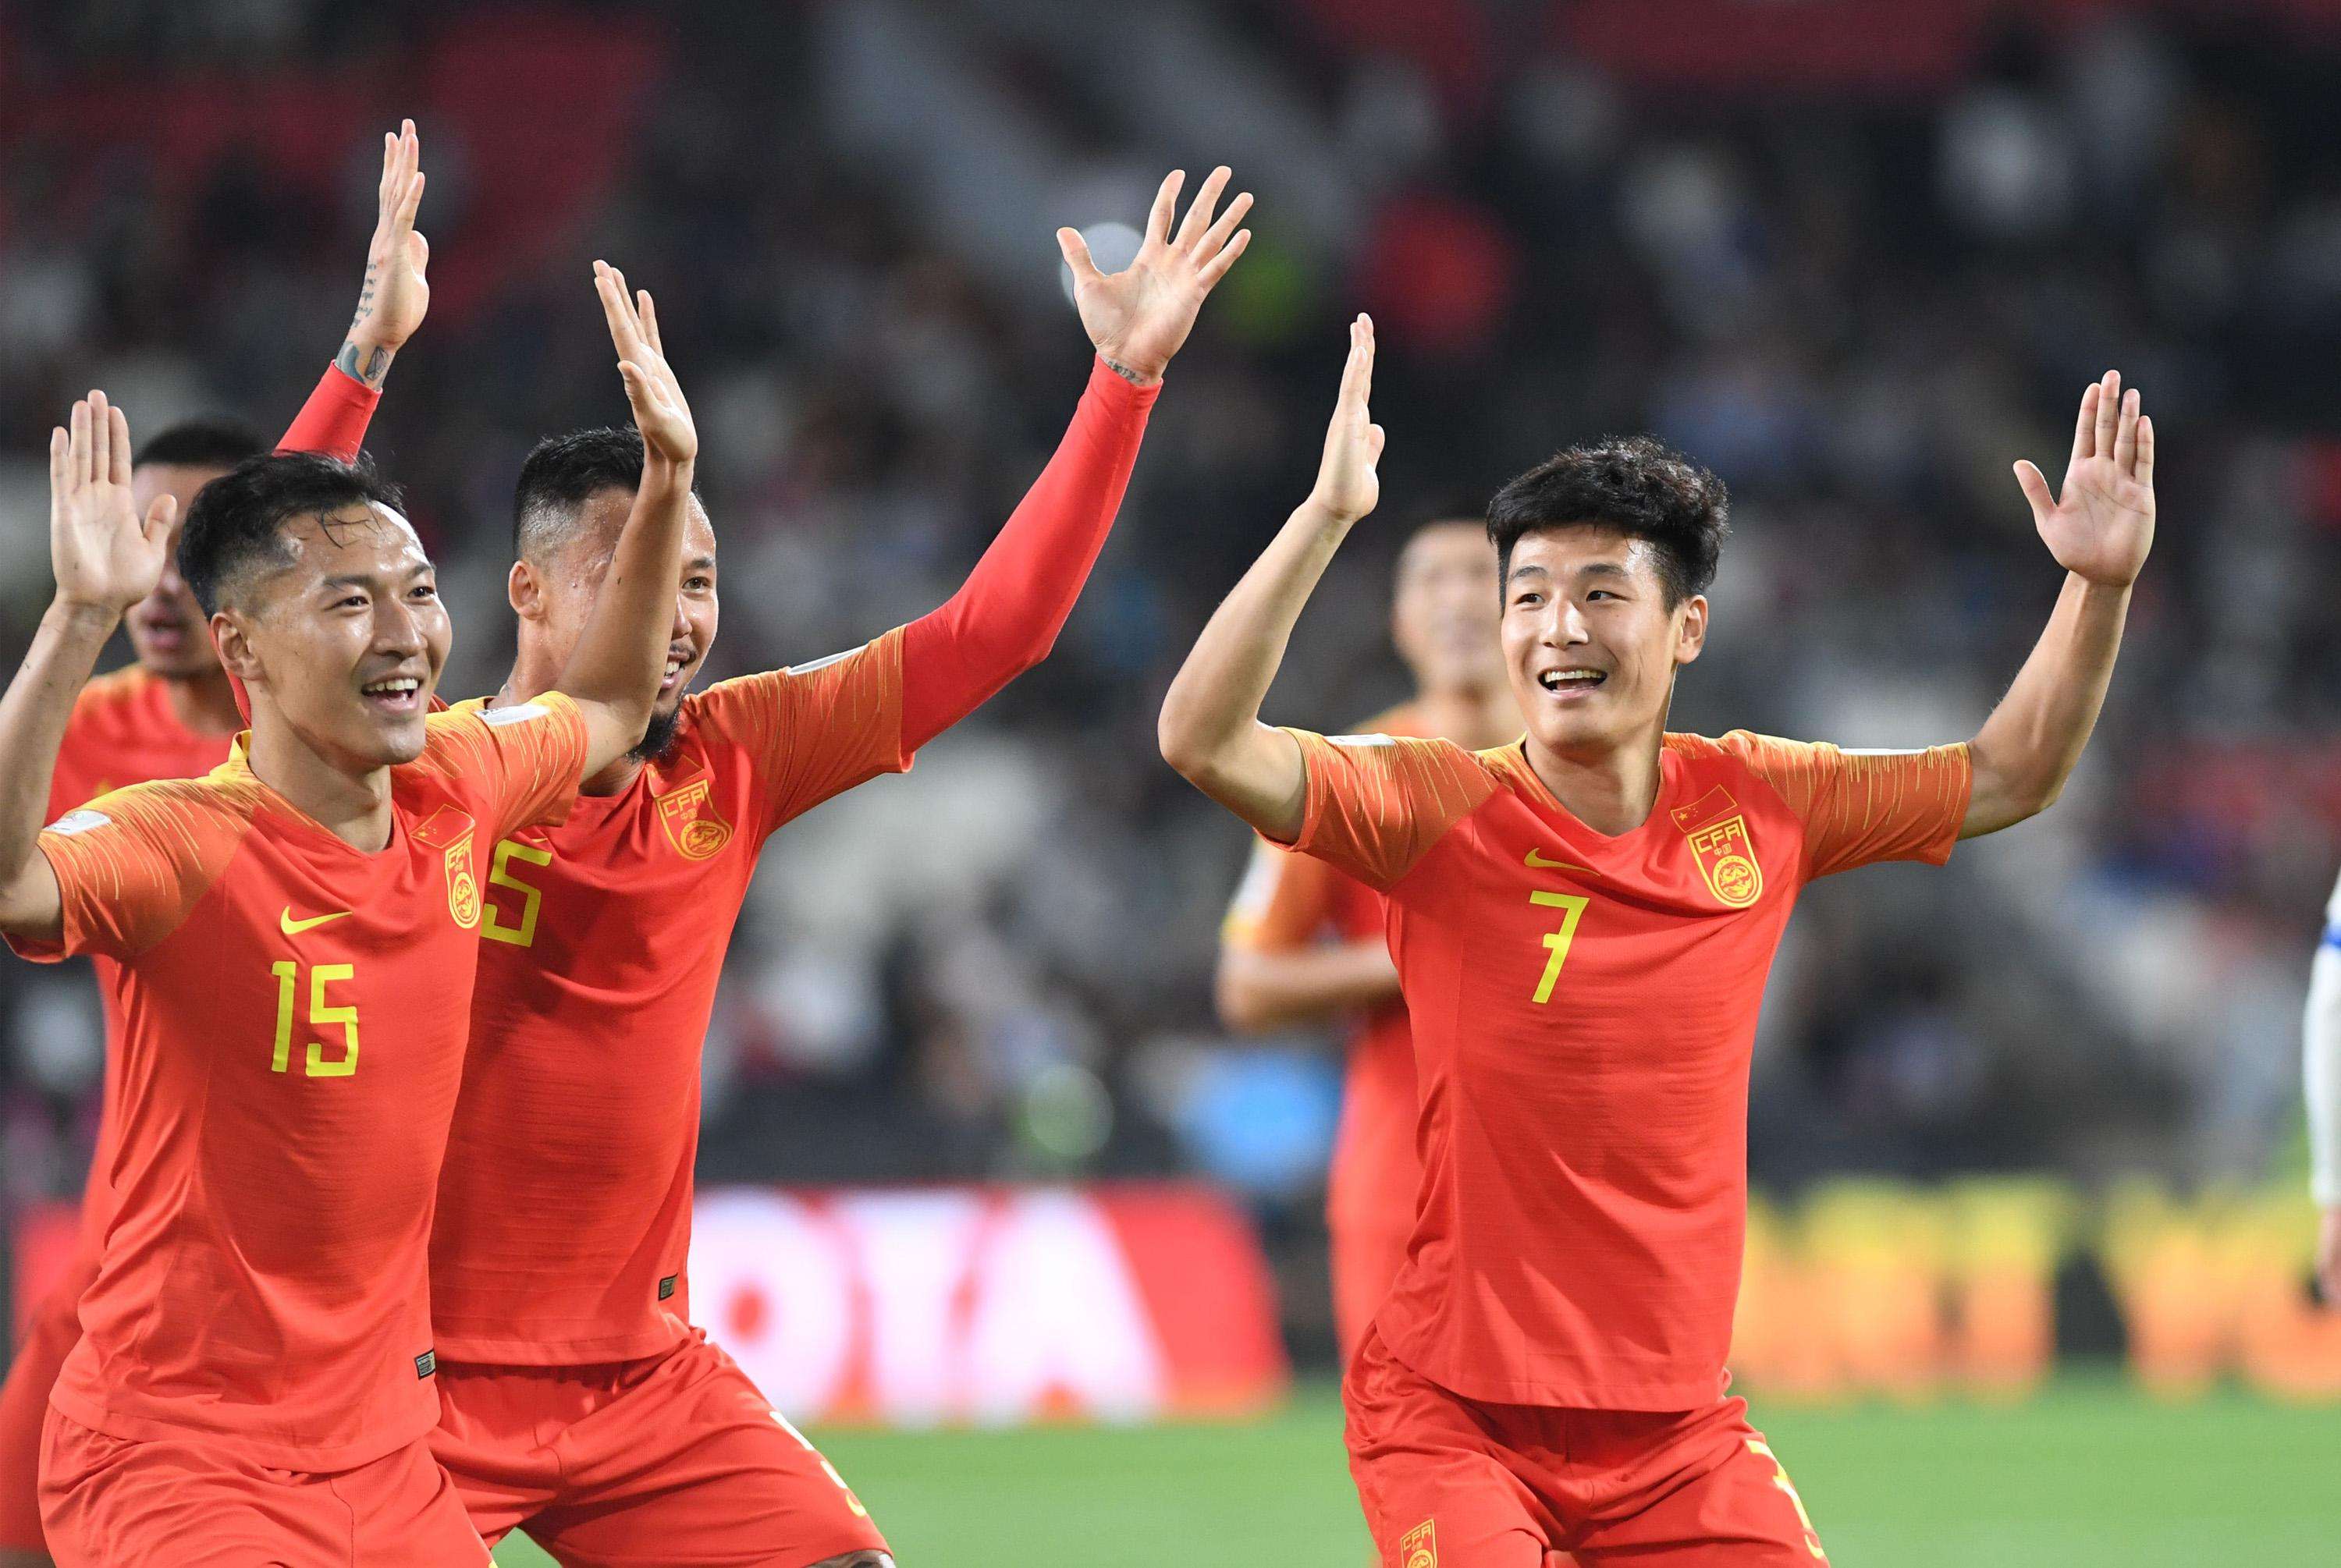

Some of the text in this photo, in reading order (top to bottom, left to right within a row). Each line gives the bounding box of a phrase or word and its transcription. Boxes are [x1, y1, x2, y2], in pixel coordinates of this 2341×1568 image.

[663, 787, 705, 818] CFA
[1695, 823, 1741, 853] CFA
[480, 839, 552, 947] 5
[1529, 890, 1590, 1004] 7
[271, 961, 359, 1077] 15
[1403, 1524, 1431, 1551] CFA
